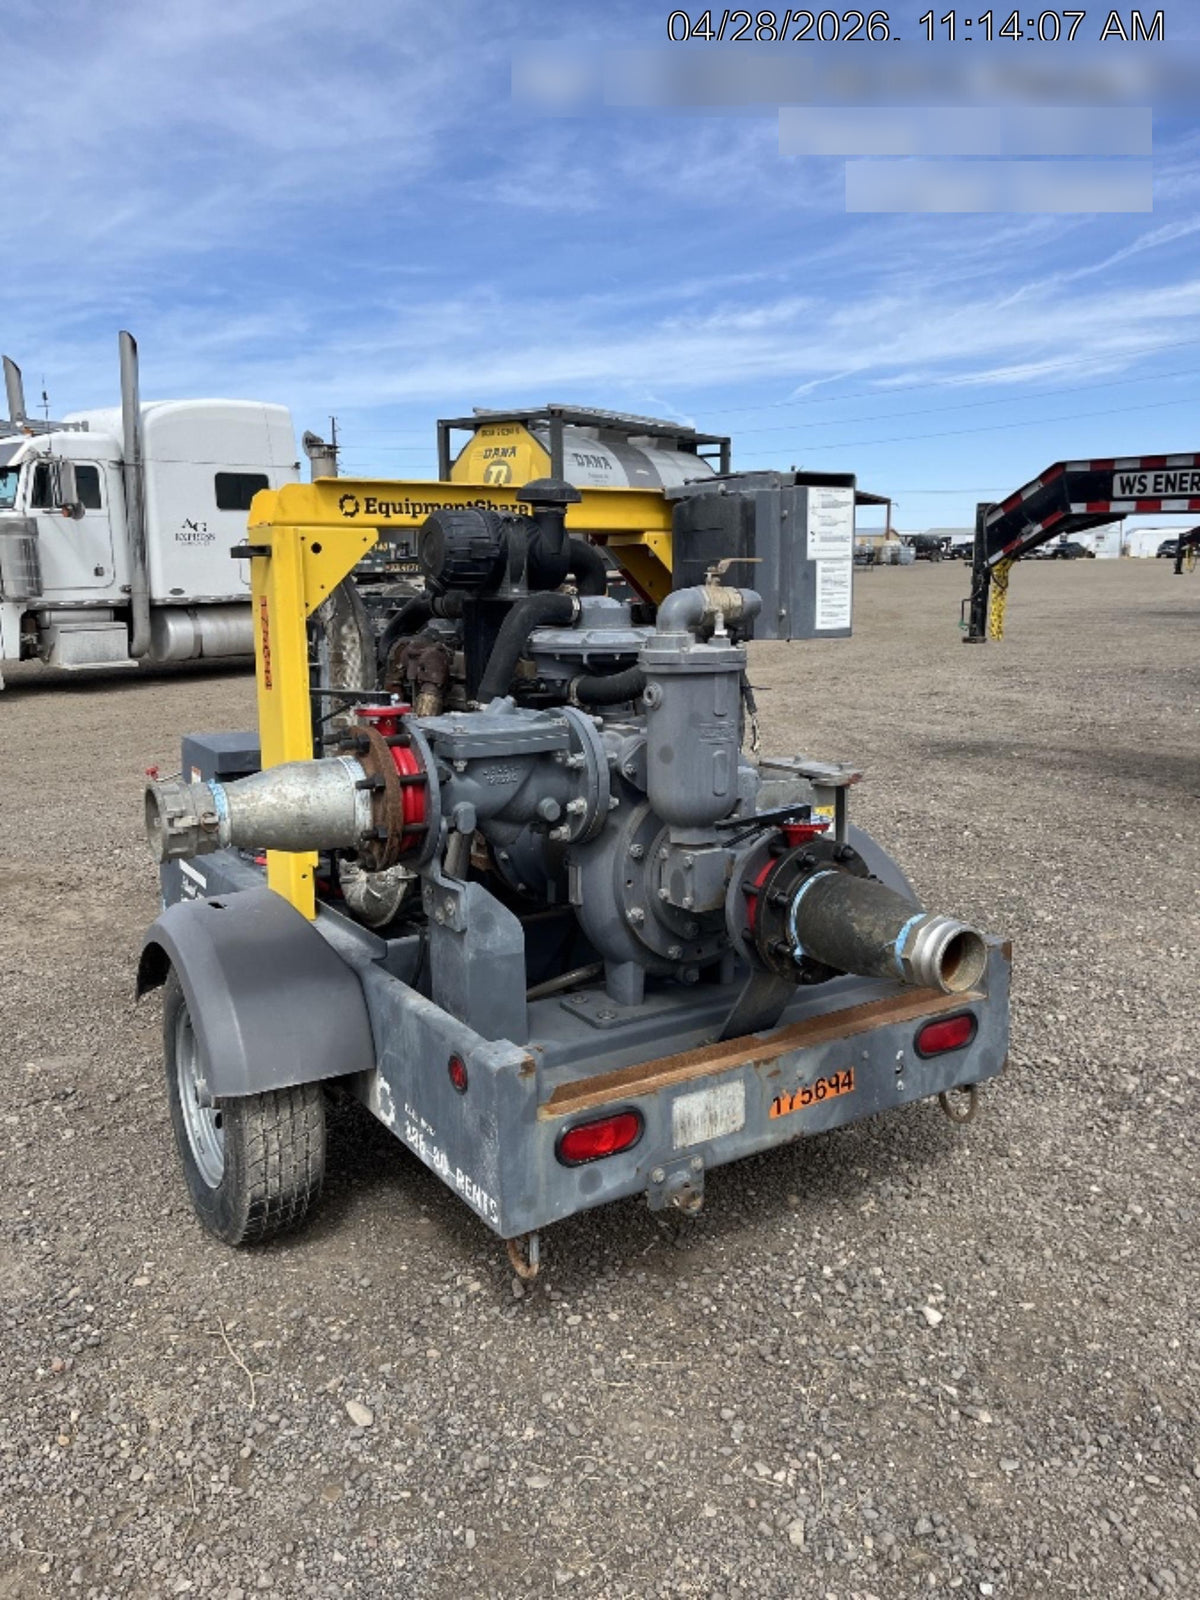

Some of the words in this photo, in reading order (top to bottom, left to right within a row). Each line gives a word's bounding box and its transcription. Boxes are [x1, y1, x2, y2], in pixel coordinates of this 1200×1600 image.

[482, 446, 517, 460] DANA
[571, 452, 613, 470] DANA
[1119, 474, 1148, 495] WS
